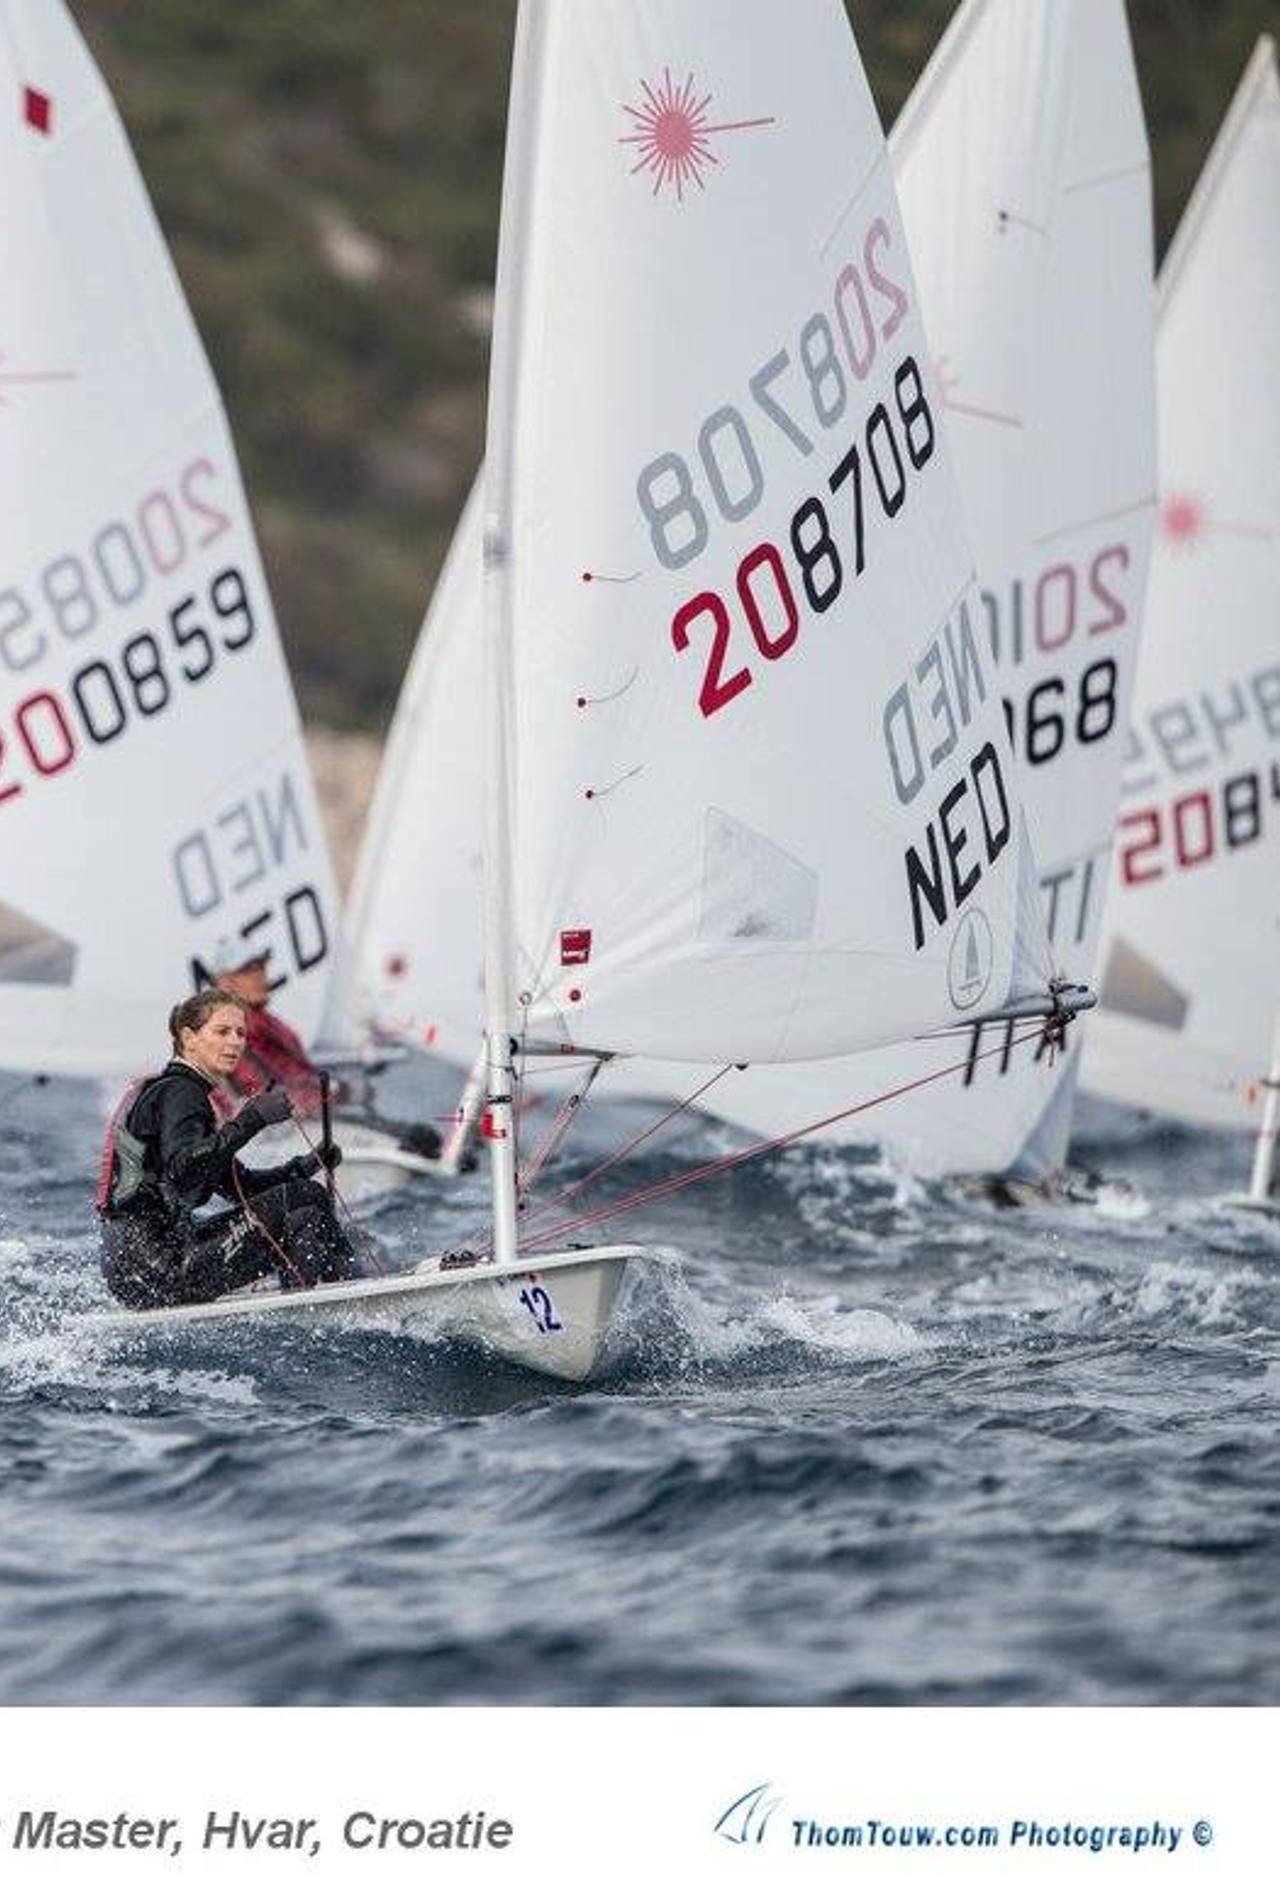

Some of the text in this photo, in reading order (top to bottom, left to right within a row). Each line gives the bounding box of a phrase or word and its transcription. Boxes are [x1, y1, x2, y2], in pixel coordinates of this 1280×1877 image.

[671, 357, 935, 718] 208708
[904, 742, 1011, 950] NED
[520, 1286, 563, 1334] 12
